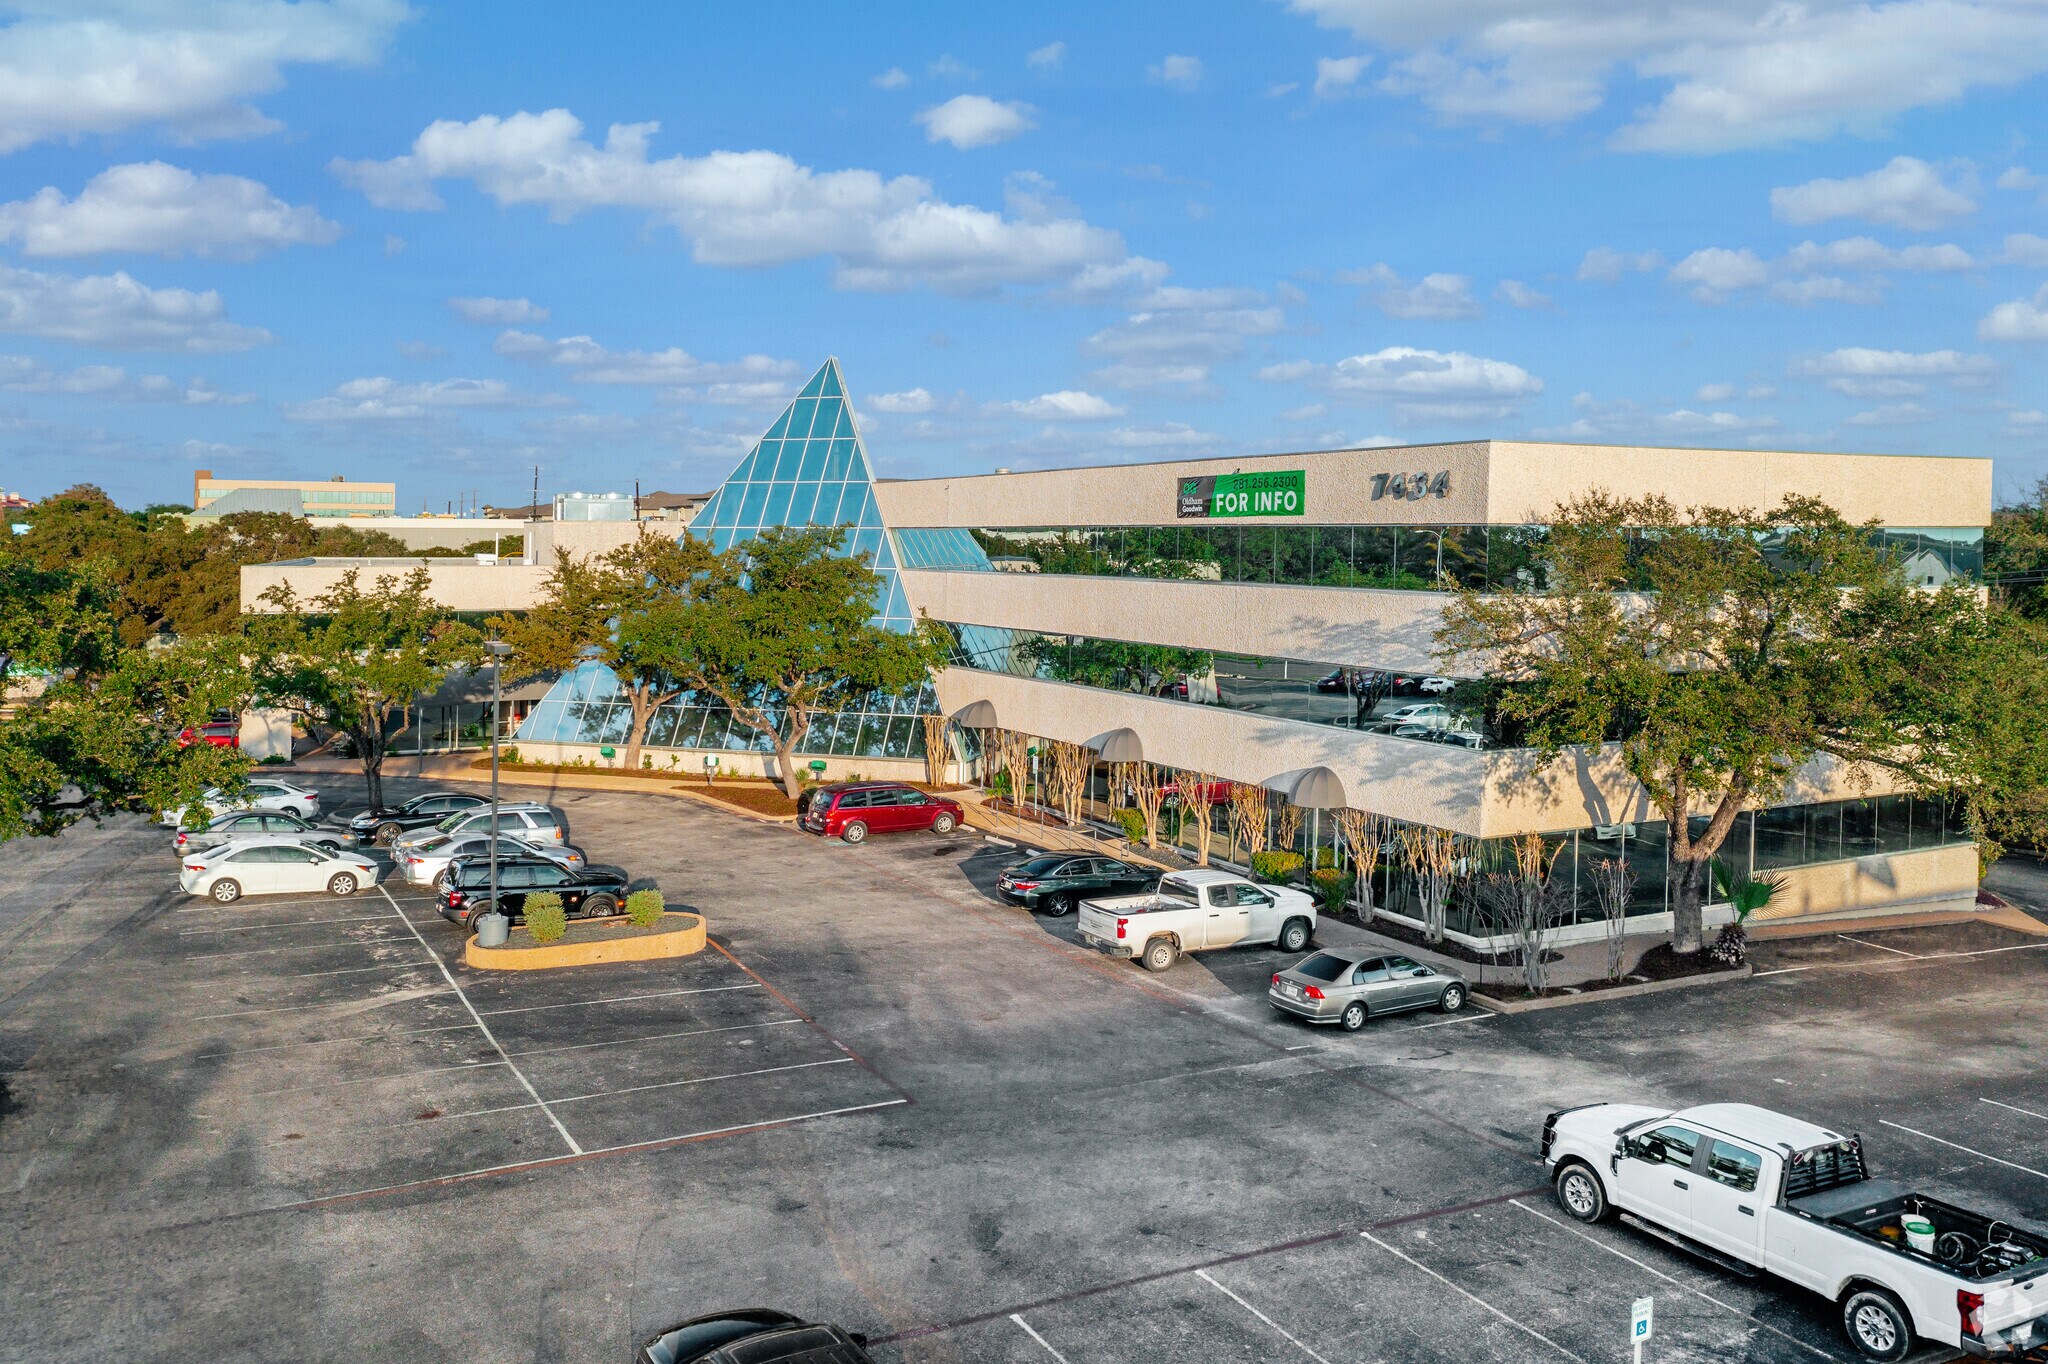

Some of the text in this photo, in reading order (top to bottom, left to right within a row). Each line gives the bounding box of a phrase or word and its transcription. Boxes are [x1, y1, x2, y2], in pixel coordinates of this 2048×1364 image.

[1233, 475, 1297, 490] 281.256.2300
[1370, 470, 1449, 501] 7434
[1182, 497, 1203, 505] Oldham
[1216, 490, 1297, 513] FOR INFO
[1182, 505, 1203, 513] Goodwin
